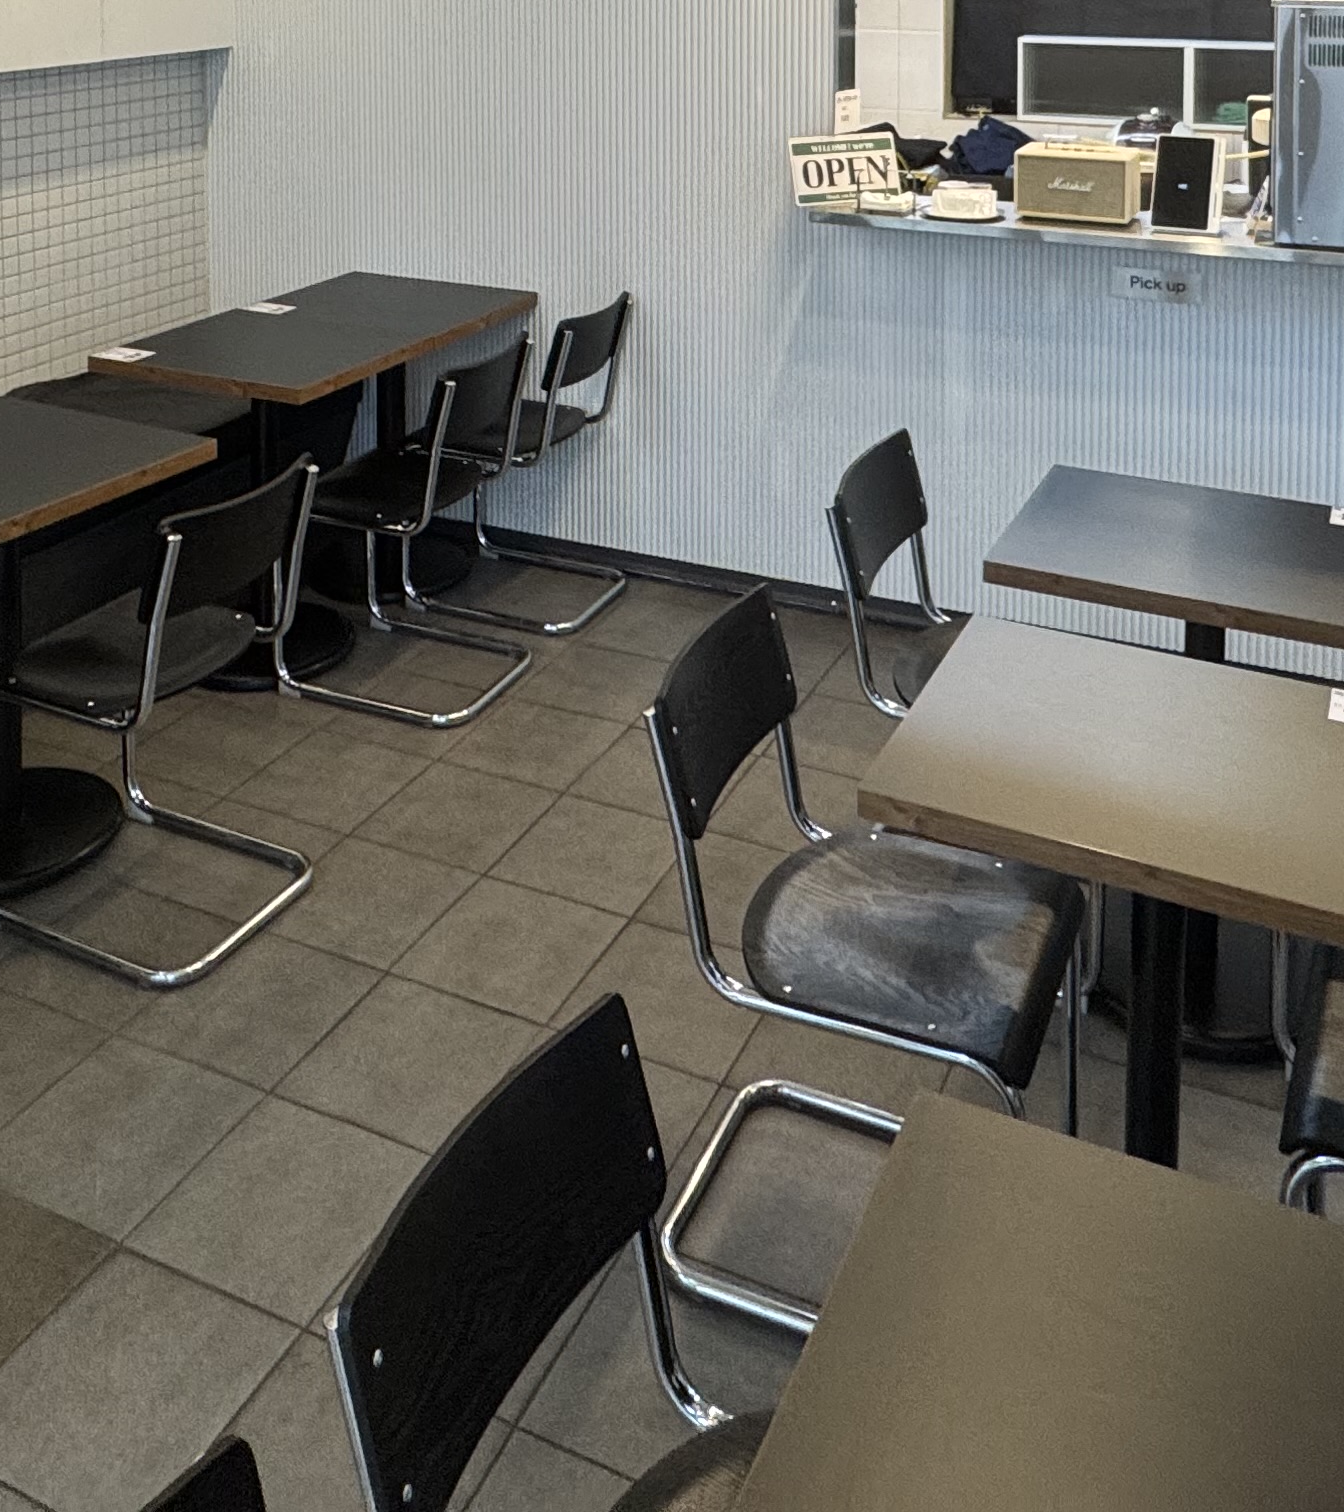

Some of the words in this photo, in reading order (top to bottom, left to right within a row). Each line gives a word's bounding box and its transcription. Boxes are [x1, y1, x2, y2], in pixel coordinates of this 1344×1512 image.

[802, 155, 888, 188] OPEN
[1048, 177, 1095, 192] Marshall
[1130, 275, 1162, 290] Pick
[1166, 281, 1186, 294] up
